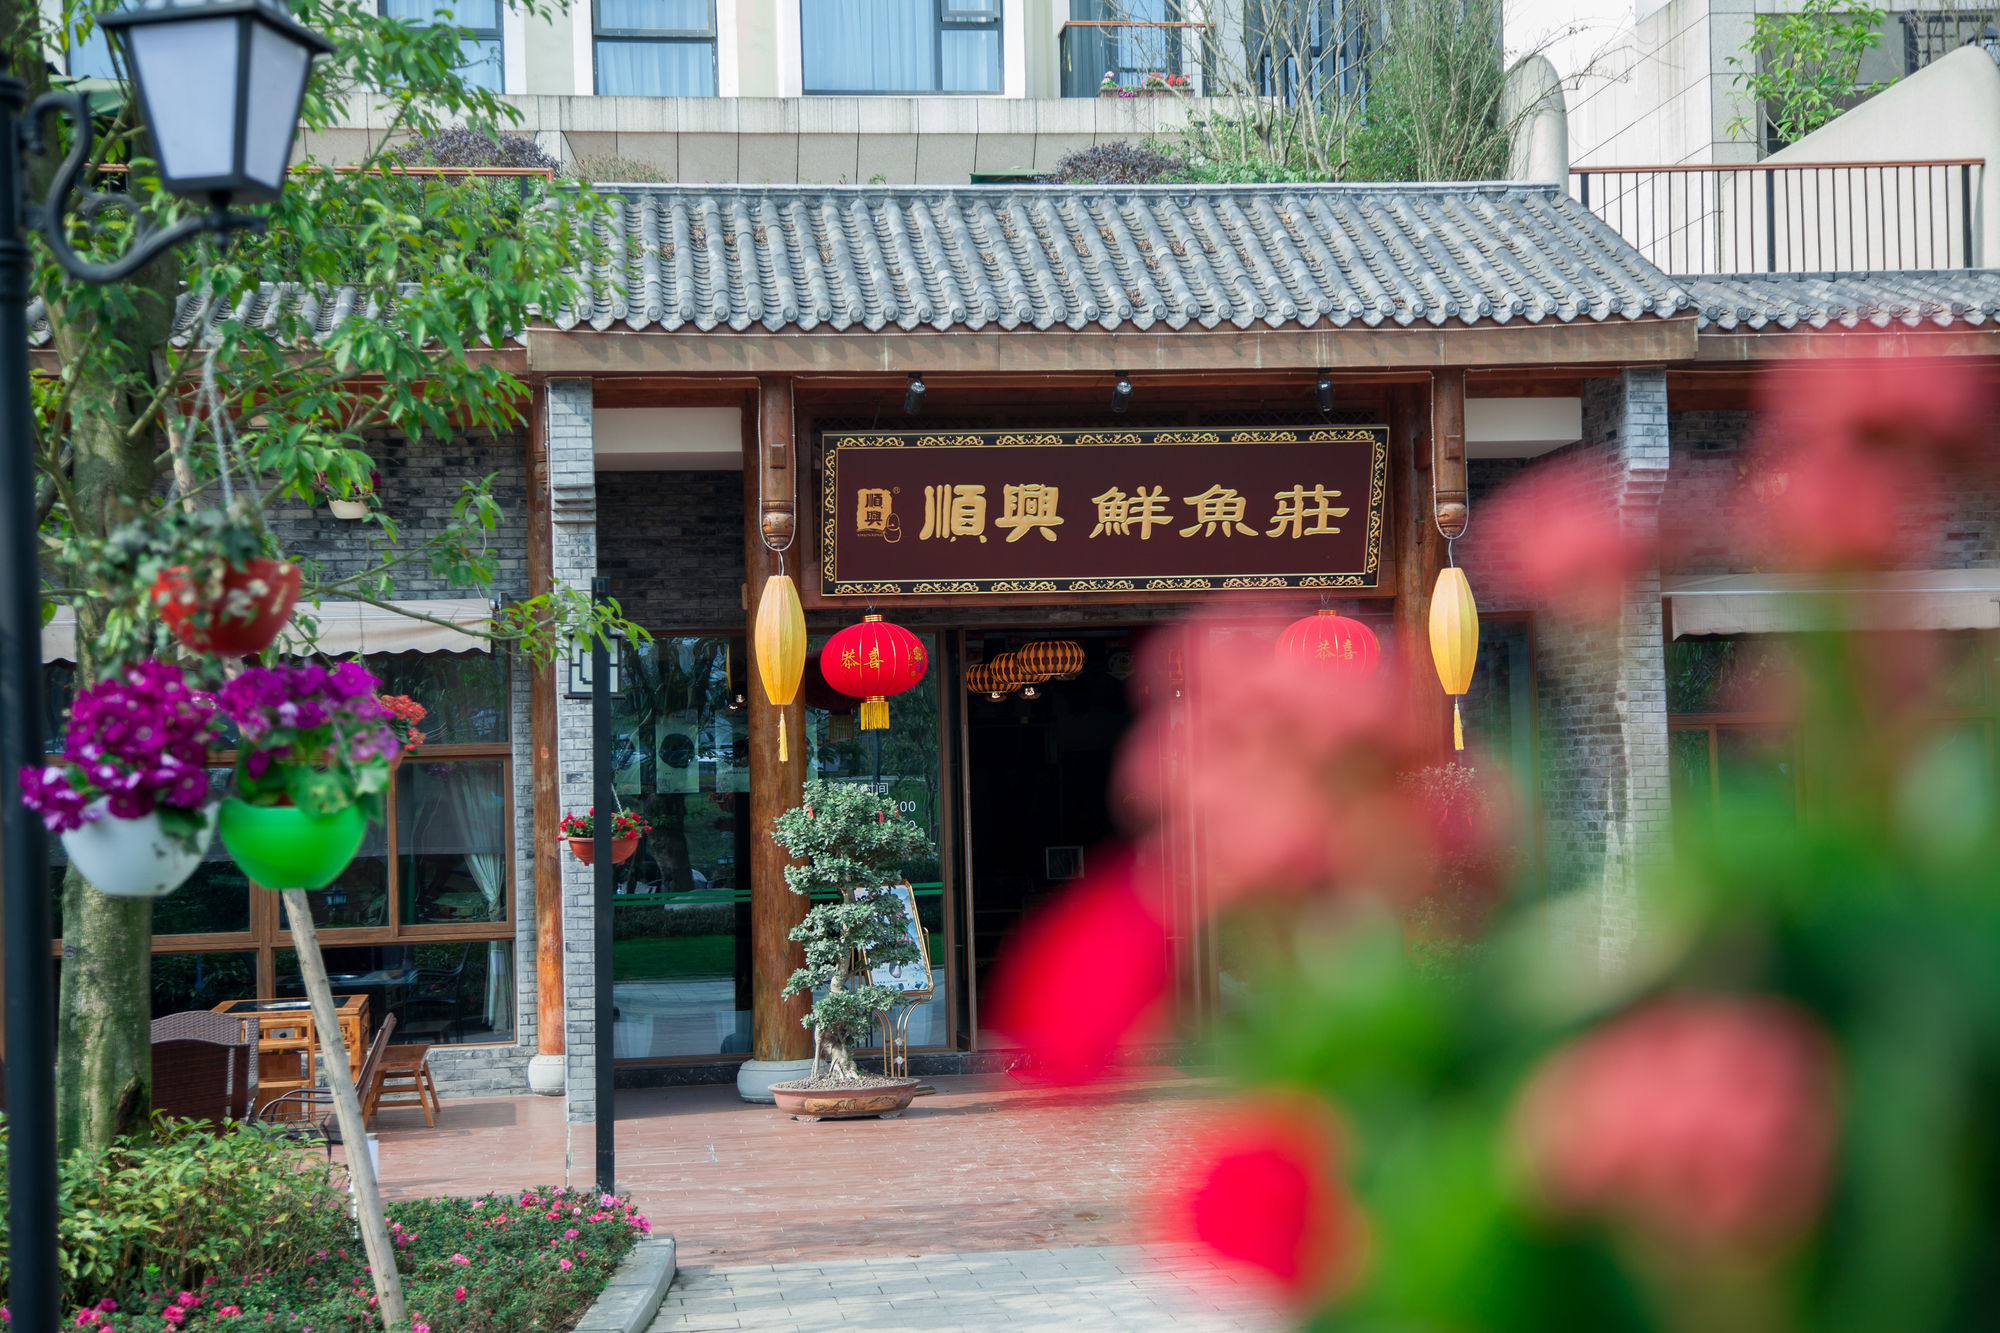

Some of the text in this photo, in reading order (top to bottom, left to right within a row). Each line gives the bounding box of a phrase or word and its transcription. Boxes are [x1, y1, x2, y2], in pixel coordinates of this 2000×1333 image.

[919, 484, 1350, 543] 順興 鮮魚莊
[841, 647, 885, 669] 恭喜
[1316, 639, 1358, 661] 恭喜
